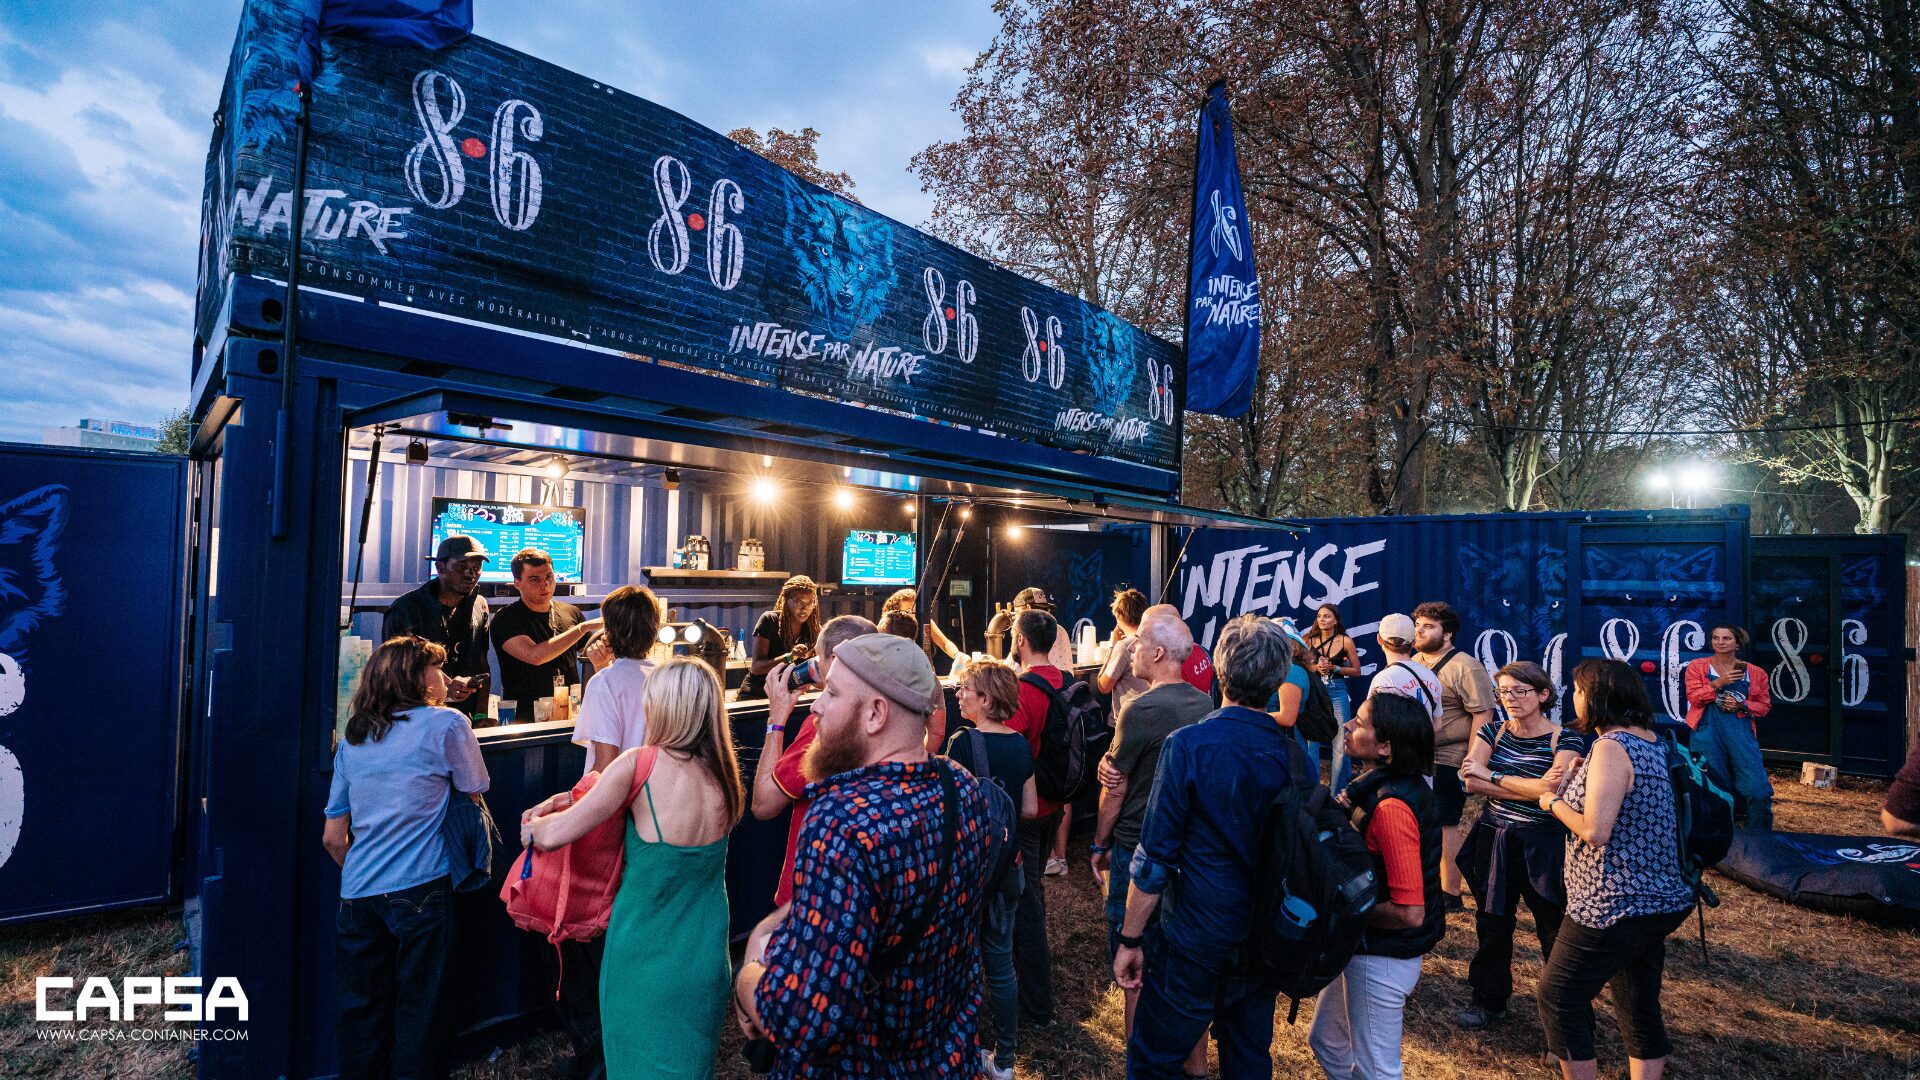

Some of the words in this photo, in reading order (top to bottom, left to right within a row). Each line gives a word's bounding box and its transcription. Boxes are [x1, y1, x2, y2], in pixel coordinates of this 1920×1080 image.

[234, 174, 413, 256] NATURE
[306, 262, 415, 295] CONSOMMER
[428, 289, 465, 305] AVEC
[1195, 296, 1213, 309] PAR
[728, 318, 826, 360] INTENSE
[822, 341, 850, 365] PAR
[847, 340, 926, 387] NATURE
[1054, 407, 1103, 432] INTENSE
[1097, 417, 1116, 434] PAR
[1107, 415, 1151, 446] NATURE
